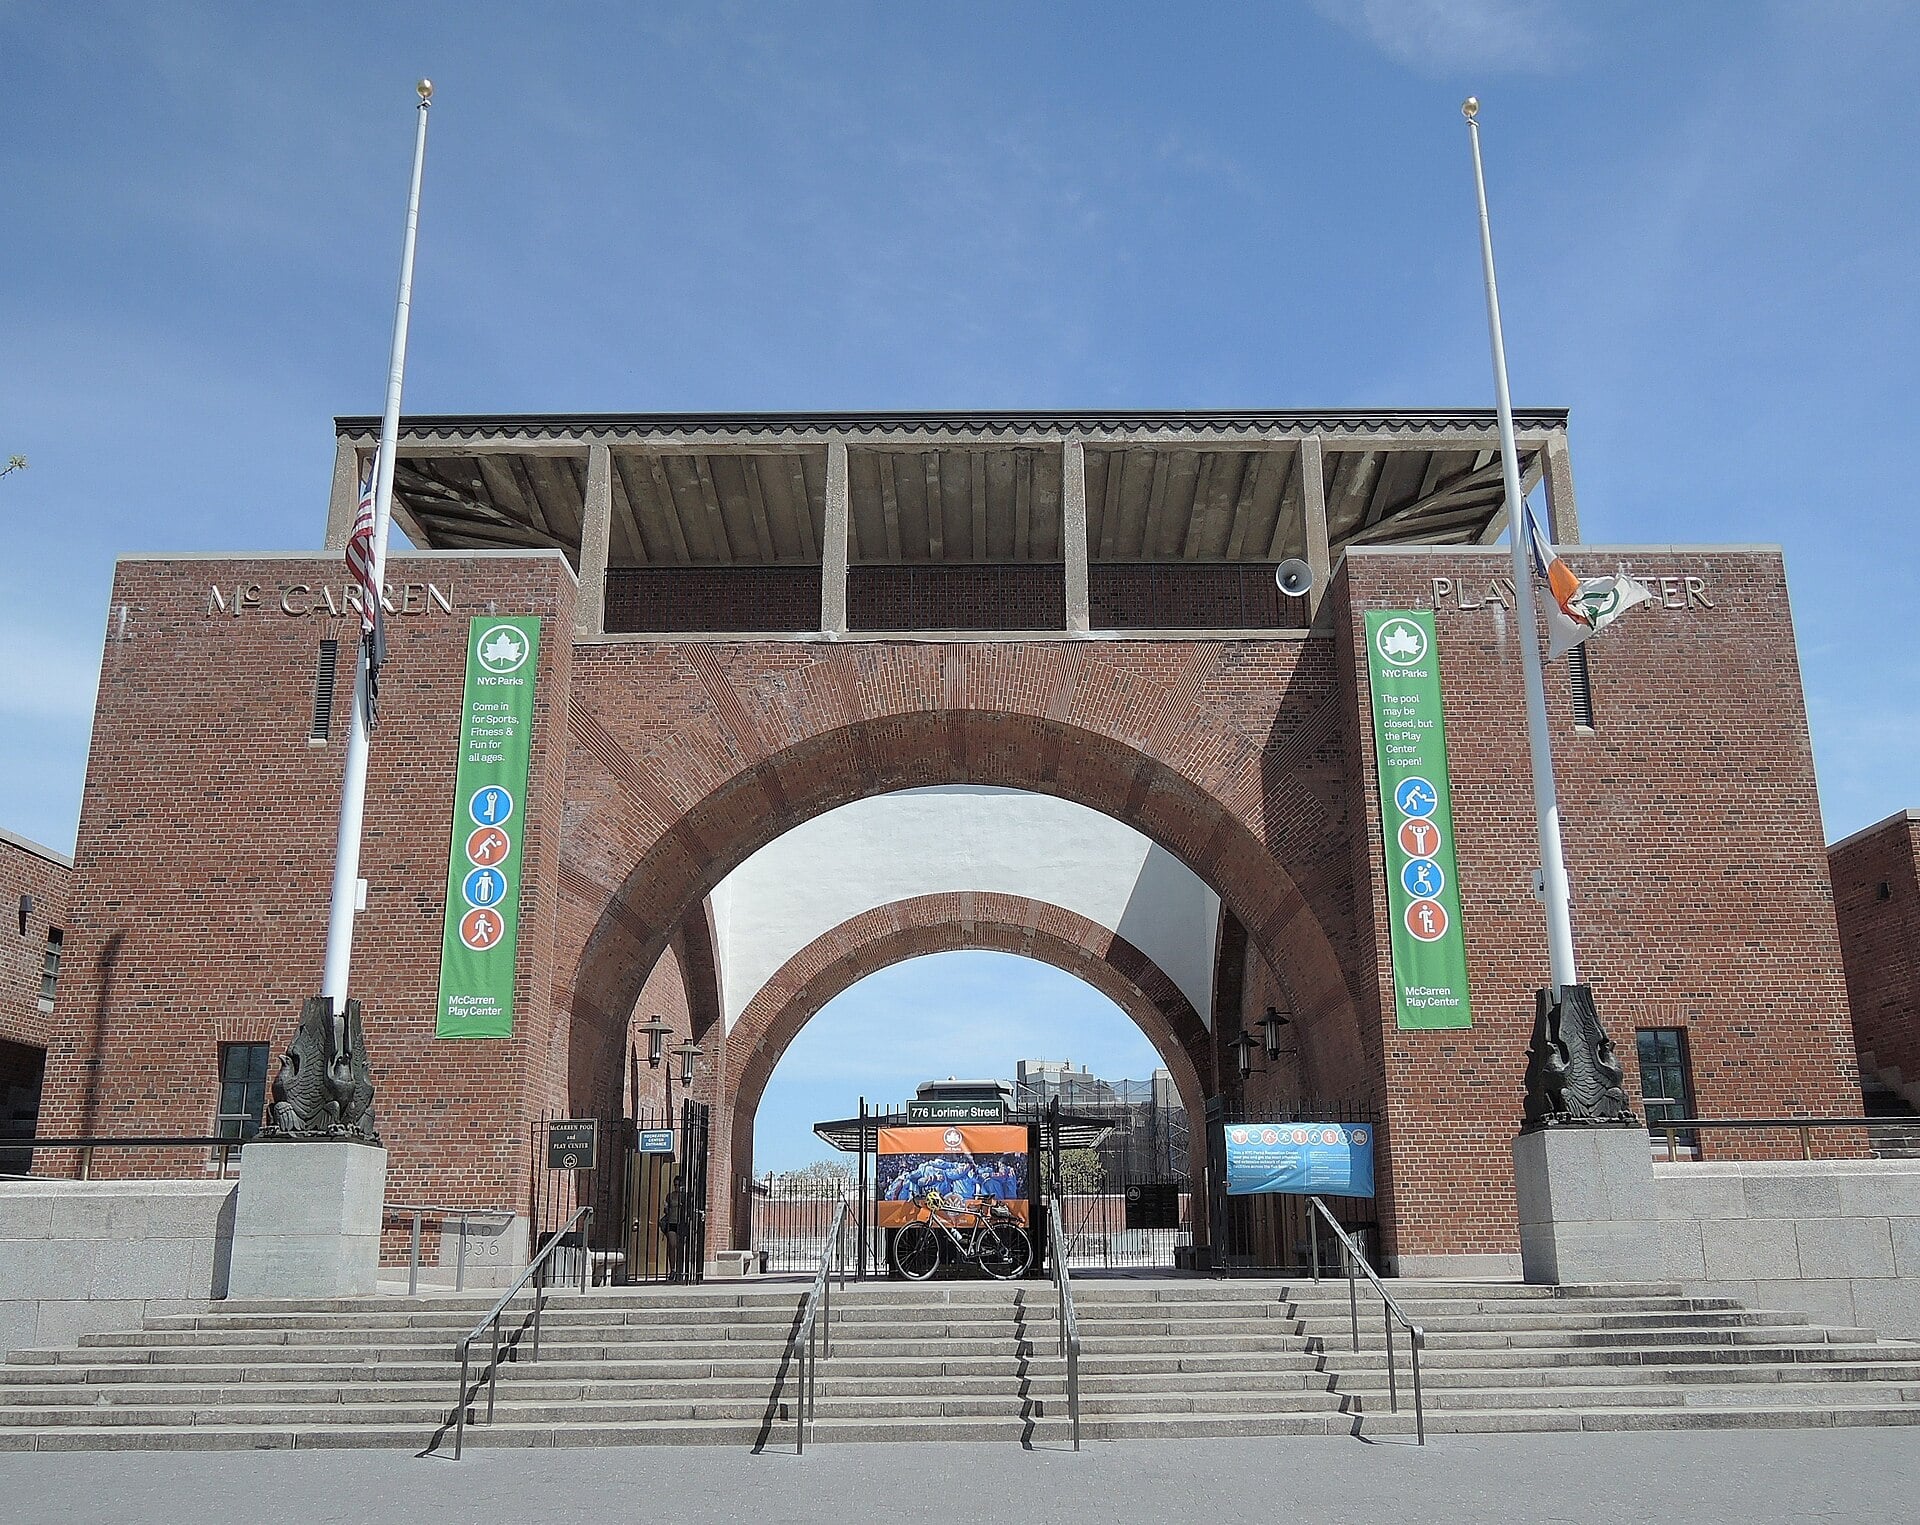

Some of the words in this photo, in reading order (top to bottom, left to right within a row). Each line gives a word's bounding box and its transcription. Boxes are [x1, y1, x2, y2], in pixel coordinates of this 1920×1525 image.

[281, 583, 453, 617] CARREN
[1382, 669, 1400, 678] NYC
[1402, 669, 1428, 678] Parks
[477, 677, 496, 686] NYC
[498, 677, 524, 686] Parks
[1381, 694, 1398, 703] The
[1400, 694, 1420, 705] pool
[472, 702, 499, 711] Come
[500, 702, 509, 711] in
[1383, 708, 1402, 717] may
[1404, 707, 1415, 715] be
[472, 715, 485, 724] for
[486, 715, 519, 725] Sports,
[1384, 719, 1416, 729] closed,
[1417, 719, 1433, 728] but
[471, 727, 504, 736] Fitness
[505, 727, 514, 736] &
[1385, 732, 1400, 741] the
[1402, 732, 1421, 742] Play
[470, 740, 487, 749] Fun
[488, 740, 502, 749] for
[1386, 744, 1417, 753] Center
[468, 753, 480, 762] all
[481, 754, 505, 763] ages.
[1387, 757, 1396, 766] is
[1396, 757, 1422, 767] open!
[1405, 986, 1451, 996] McCarren
[449, 995, 495, 1005] McCarren
[1406, 997, 1427, 1009] Play
[1427, 997, 1459, 1007] Center
[448, 1006, 469, 1017] Play
[469, 1006, 502, 1016] Center
[911, 1107, 929, 1117] 776
[931, 1107, 968, 1117] Lorimer
[970, 1106, 1000, 1117] Street
